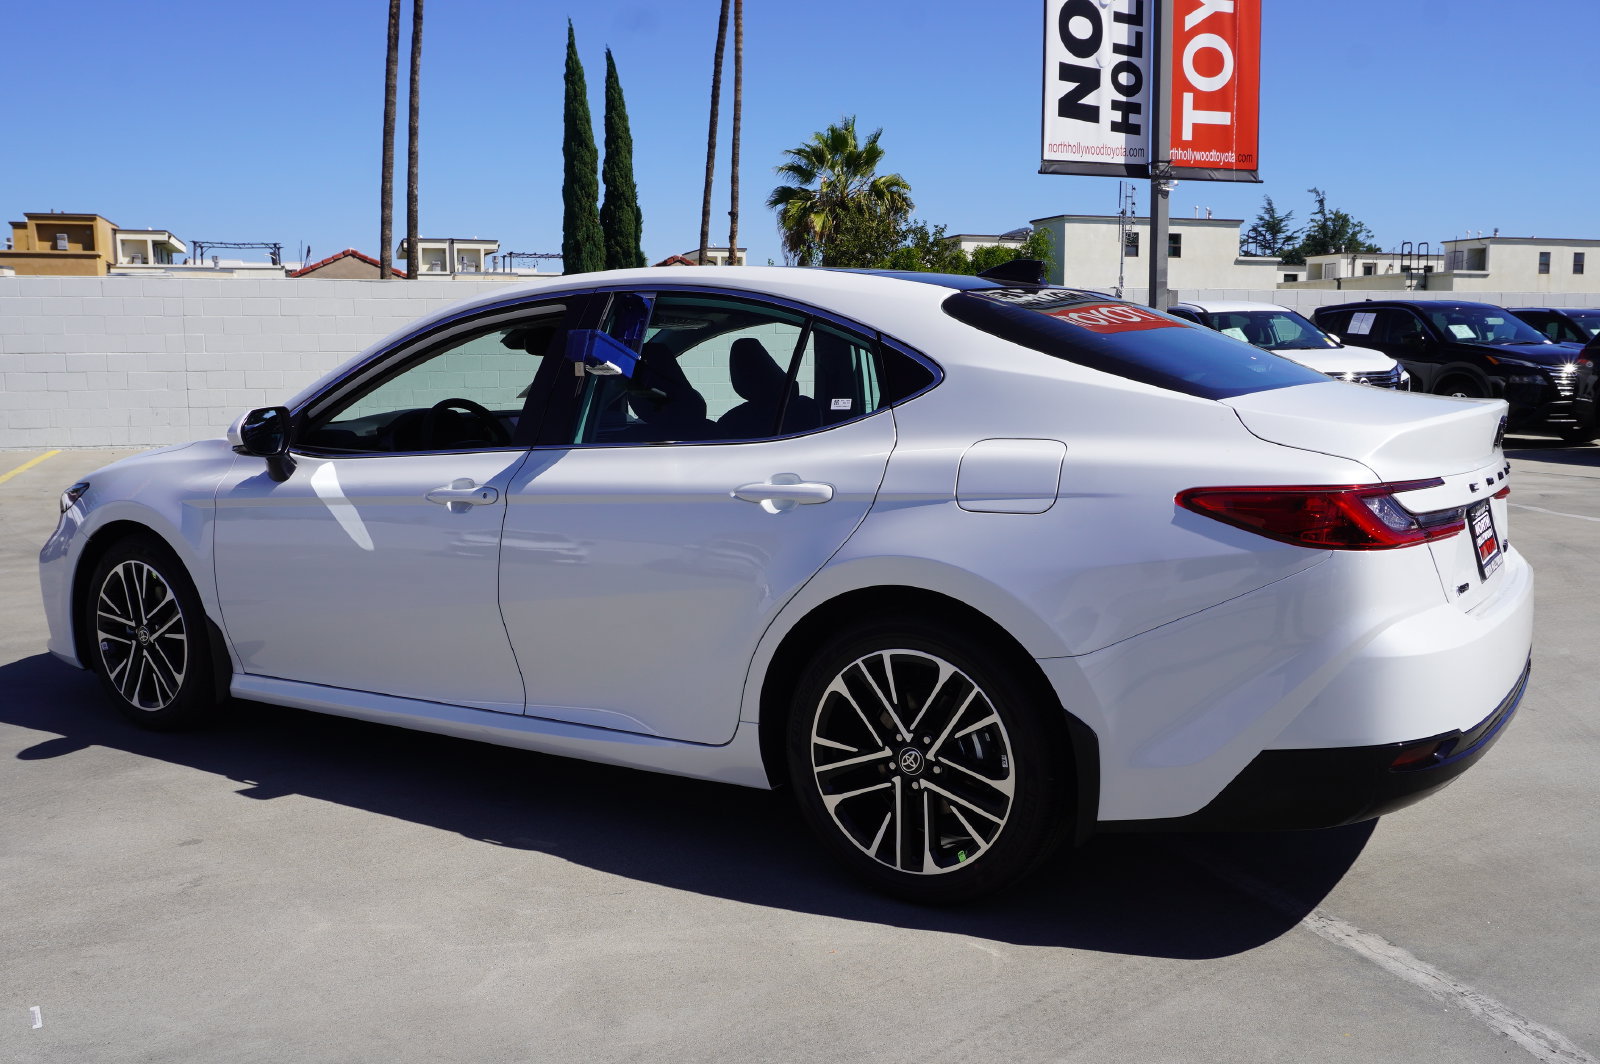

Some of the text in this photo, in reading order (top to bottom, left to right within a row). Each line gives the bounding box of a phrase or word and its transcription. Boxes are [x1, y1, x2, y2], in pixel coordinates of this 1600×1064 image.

[1058, 0, 1103, 124] NO
[1110, 0, 1144, 136] HOLL
[1181, 0, 1235, 141] TOY
[1048, 141, 1145, 159] northhollywoodtoyota.com
[1170, 147, 1253, 166] rthhollywoodtoyota.com
